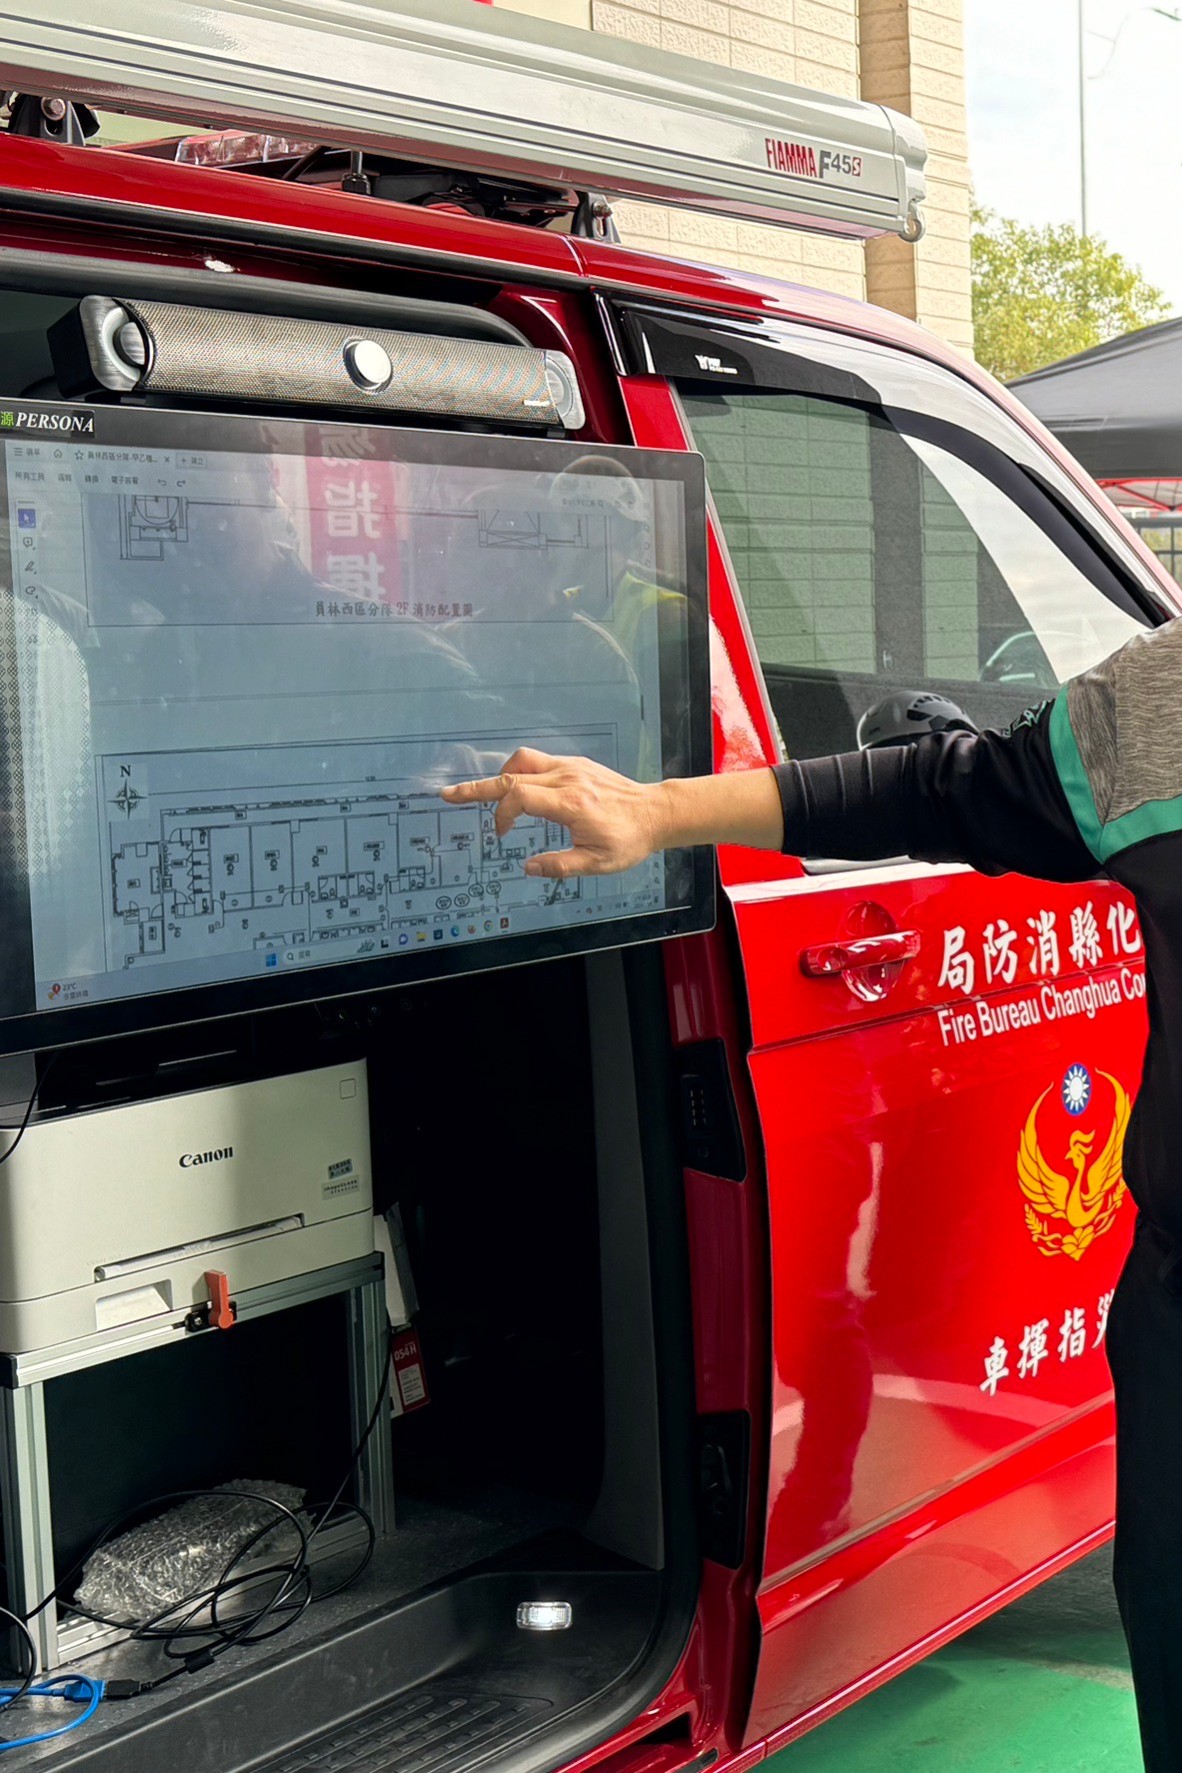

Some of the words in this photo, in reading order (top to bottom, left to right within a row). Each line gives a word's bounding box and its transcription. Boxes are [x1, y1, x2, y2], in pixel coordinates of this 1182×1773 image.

[765, 137, 818, 178] FIAMMA
[16, 411, 95, 433] PERSONA
[120, 765, 132, 778] N
[937, 1009, 977, 1047] Fire
[976, 1001, 1041, 1037] Bureau
[1040, 975, 1122, 1020] Changhua
[178, 1146, 234, 1169] Canon
